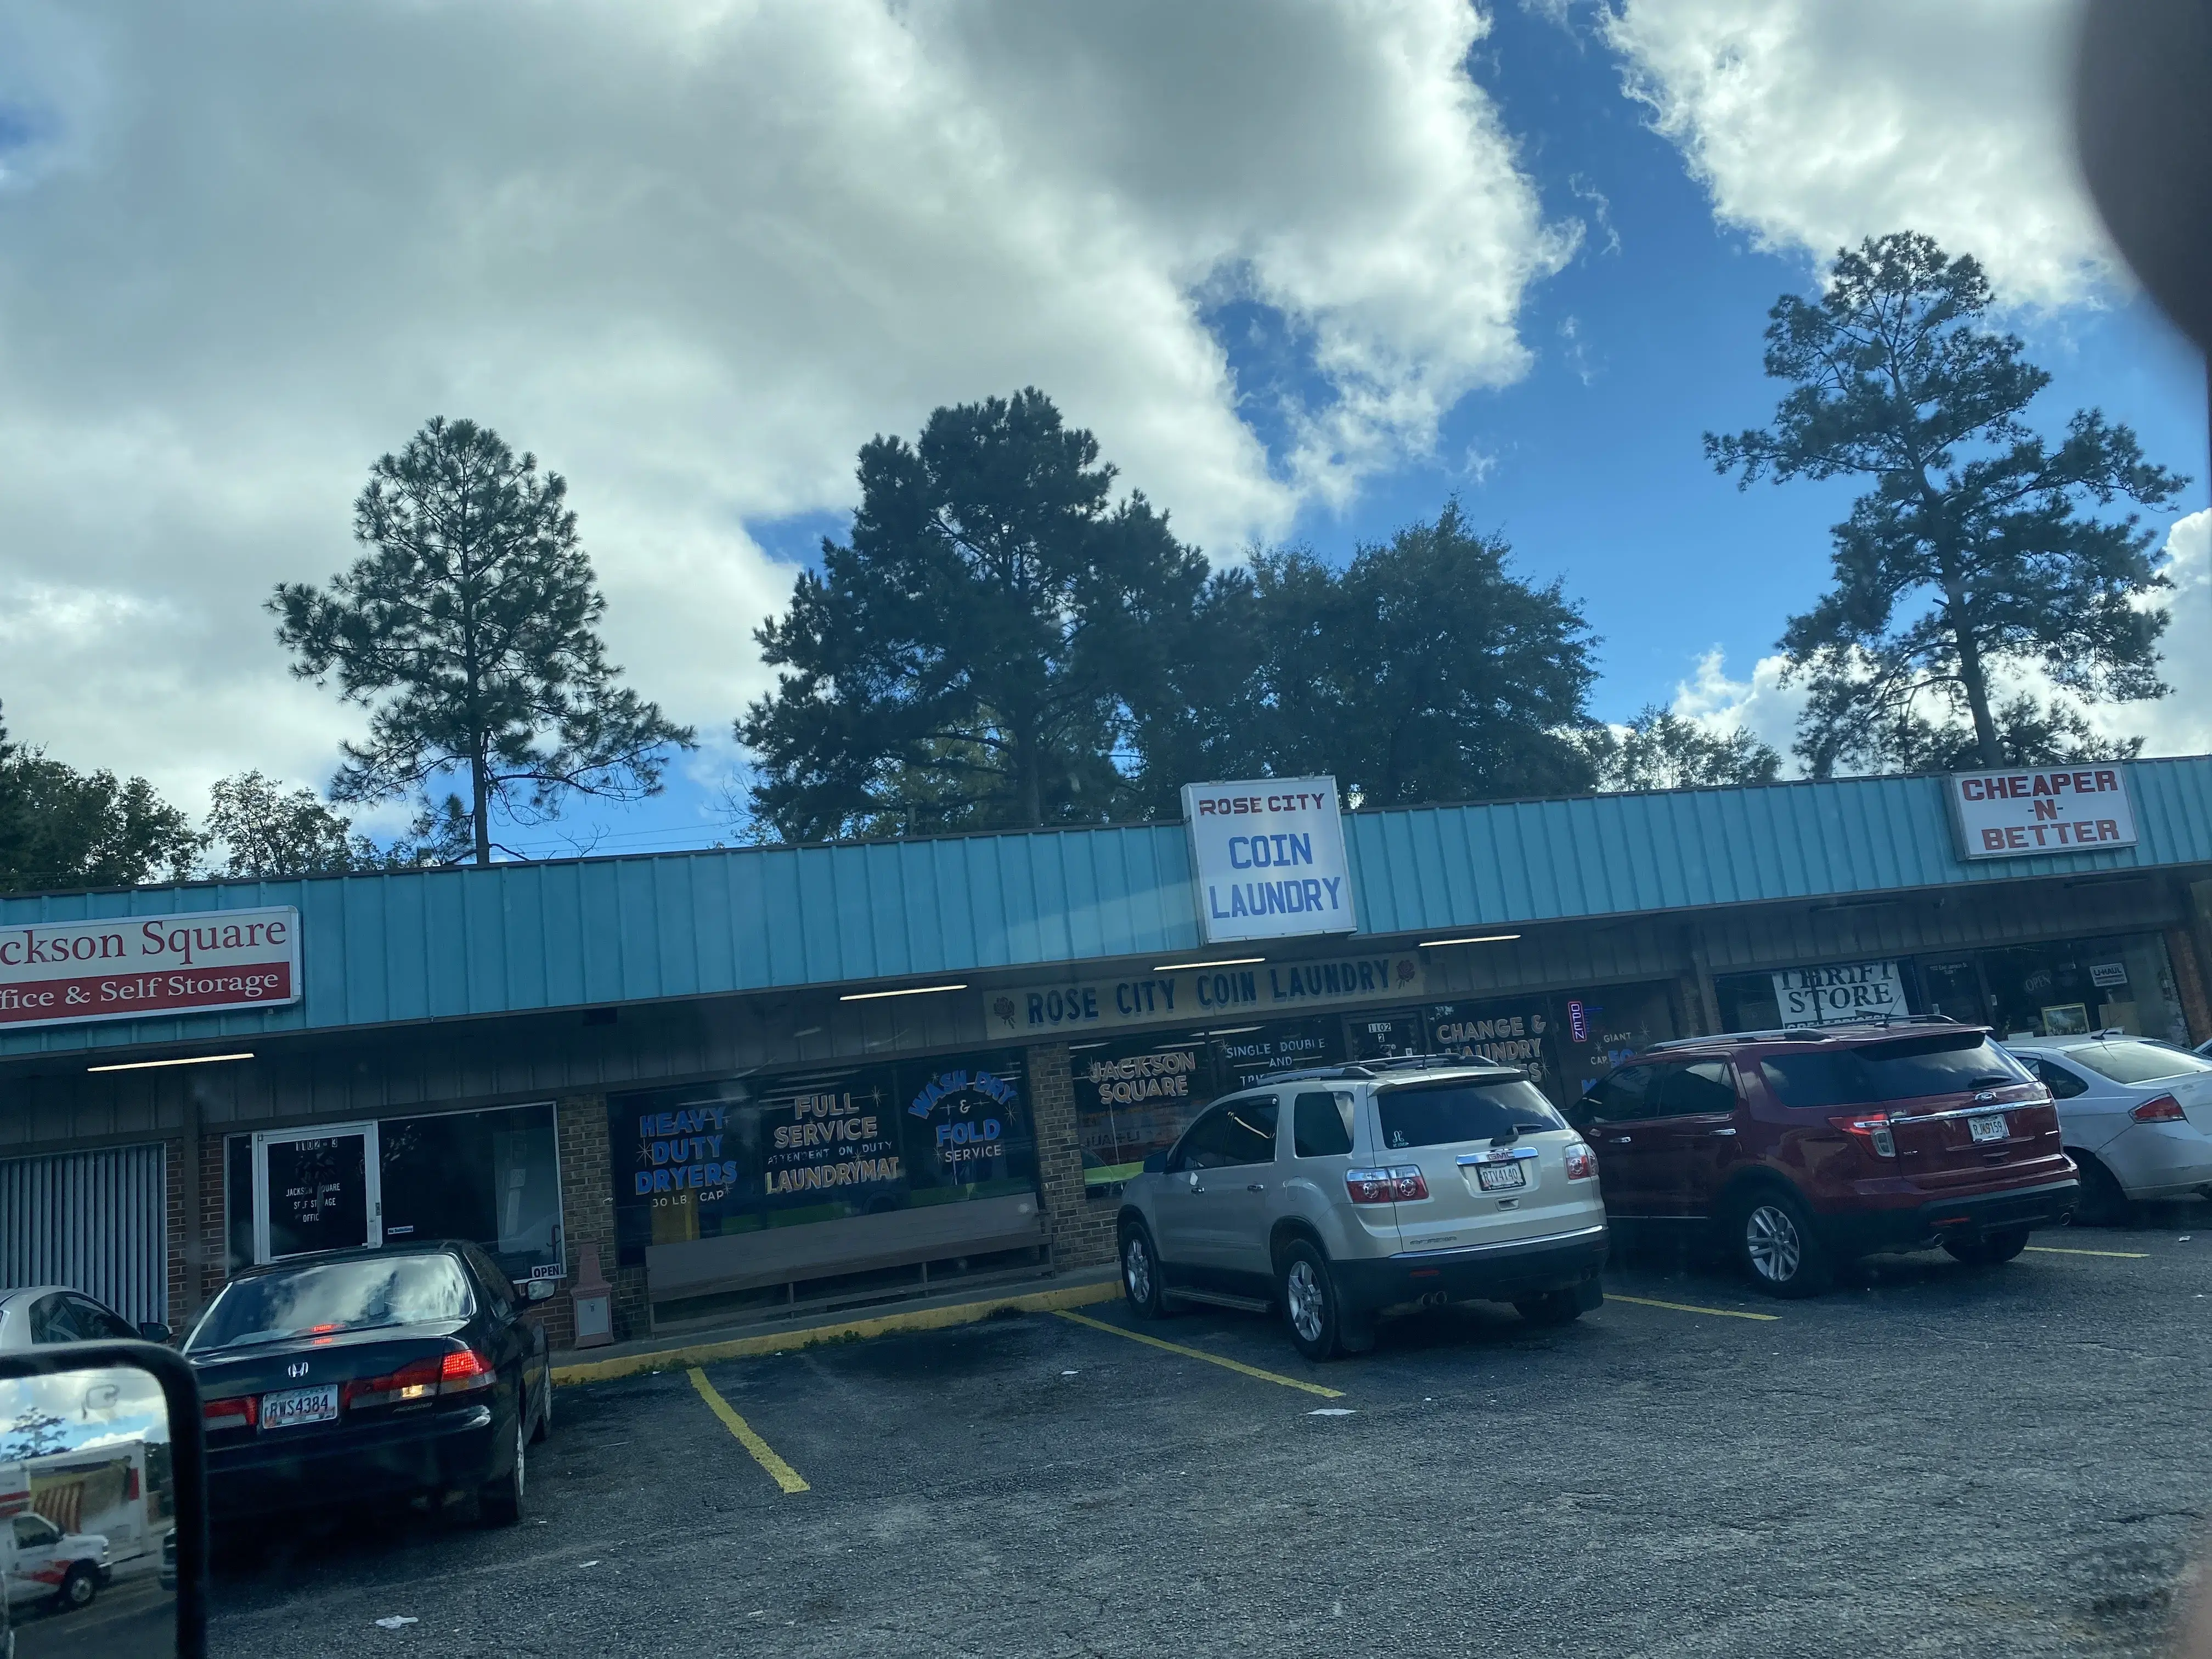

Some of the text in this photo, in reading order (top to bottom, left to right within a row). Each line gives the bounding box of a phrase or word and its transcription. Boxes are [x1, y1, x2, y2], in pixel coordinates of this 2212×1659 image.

[1962, 770, 2118, 801] CHEAPER
[1199, 793, 1325, 816] ROSE CITY
[1981, 820, 2120, 850] BETTER
[1229, 833, 1313, 869] COIN
[1209, 877, 1340, 919] LAUNDRY
[142, 920, 286, 965] Square
[2094, 967, 2122, 976] U-HAUL
[0, 973, 279, 1010] fice & Self Storage
[1026, 959, 1390, 1026] ROSE CITY COIN LAUNDRY
[1788, 983, 1893, 1013] STORE
[1369, 1023, 1391, 1032] 1102
[1436, 1014, 1547, 1045] CHANGE &
[1571, 1003, 1585, 1040] OPEN
[1378, 1034, 1385, 1042] 2
[1604, 1032, 1632, 1043] GIANT
[1089, 1051, 1196, 1084] JACKSON
[1269, 1056, 1293, 1068] AND
[907, 1069, 1018, 1120] WASH DRY
[1098, 1075, 1188, 1105] SQUARE
[795, 1092, 860, 1120] FULL
[960, 1099, 971, 1114] &
[639, 1106, 726, 1138] HEAVY
[774, 1116, 878, 1149] SERVICE
[935, 1119, 1001, 1148] FOLD
[652, 1133, 724, 1165] DUTY
[838, 1146, 853, 1156] ON
[862, 1141, 892, 1153] DUTY
[945, 1144, 1003, 1163] SERVICE
[1487, 1151, 1515, 1161] GMC
[318, 1183, 341, 1193] QUARE
[635, 1161, 738, 1195] DRYERS
[765, 1156, 900, 1195] LAUNDRYMAT
[1482, 1168, 1518, 1183] RTV4140
[311, 1198, 336, 1208] STAGE
[652, 1198, 668, 1207] 30
[699, 1190, 724, 1201] CAP
[533, 1265, 560, 1278] OPEN
